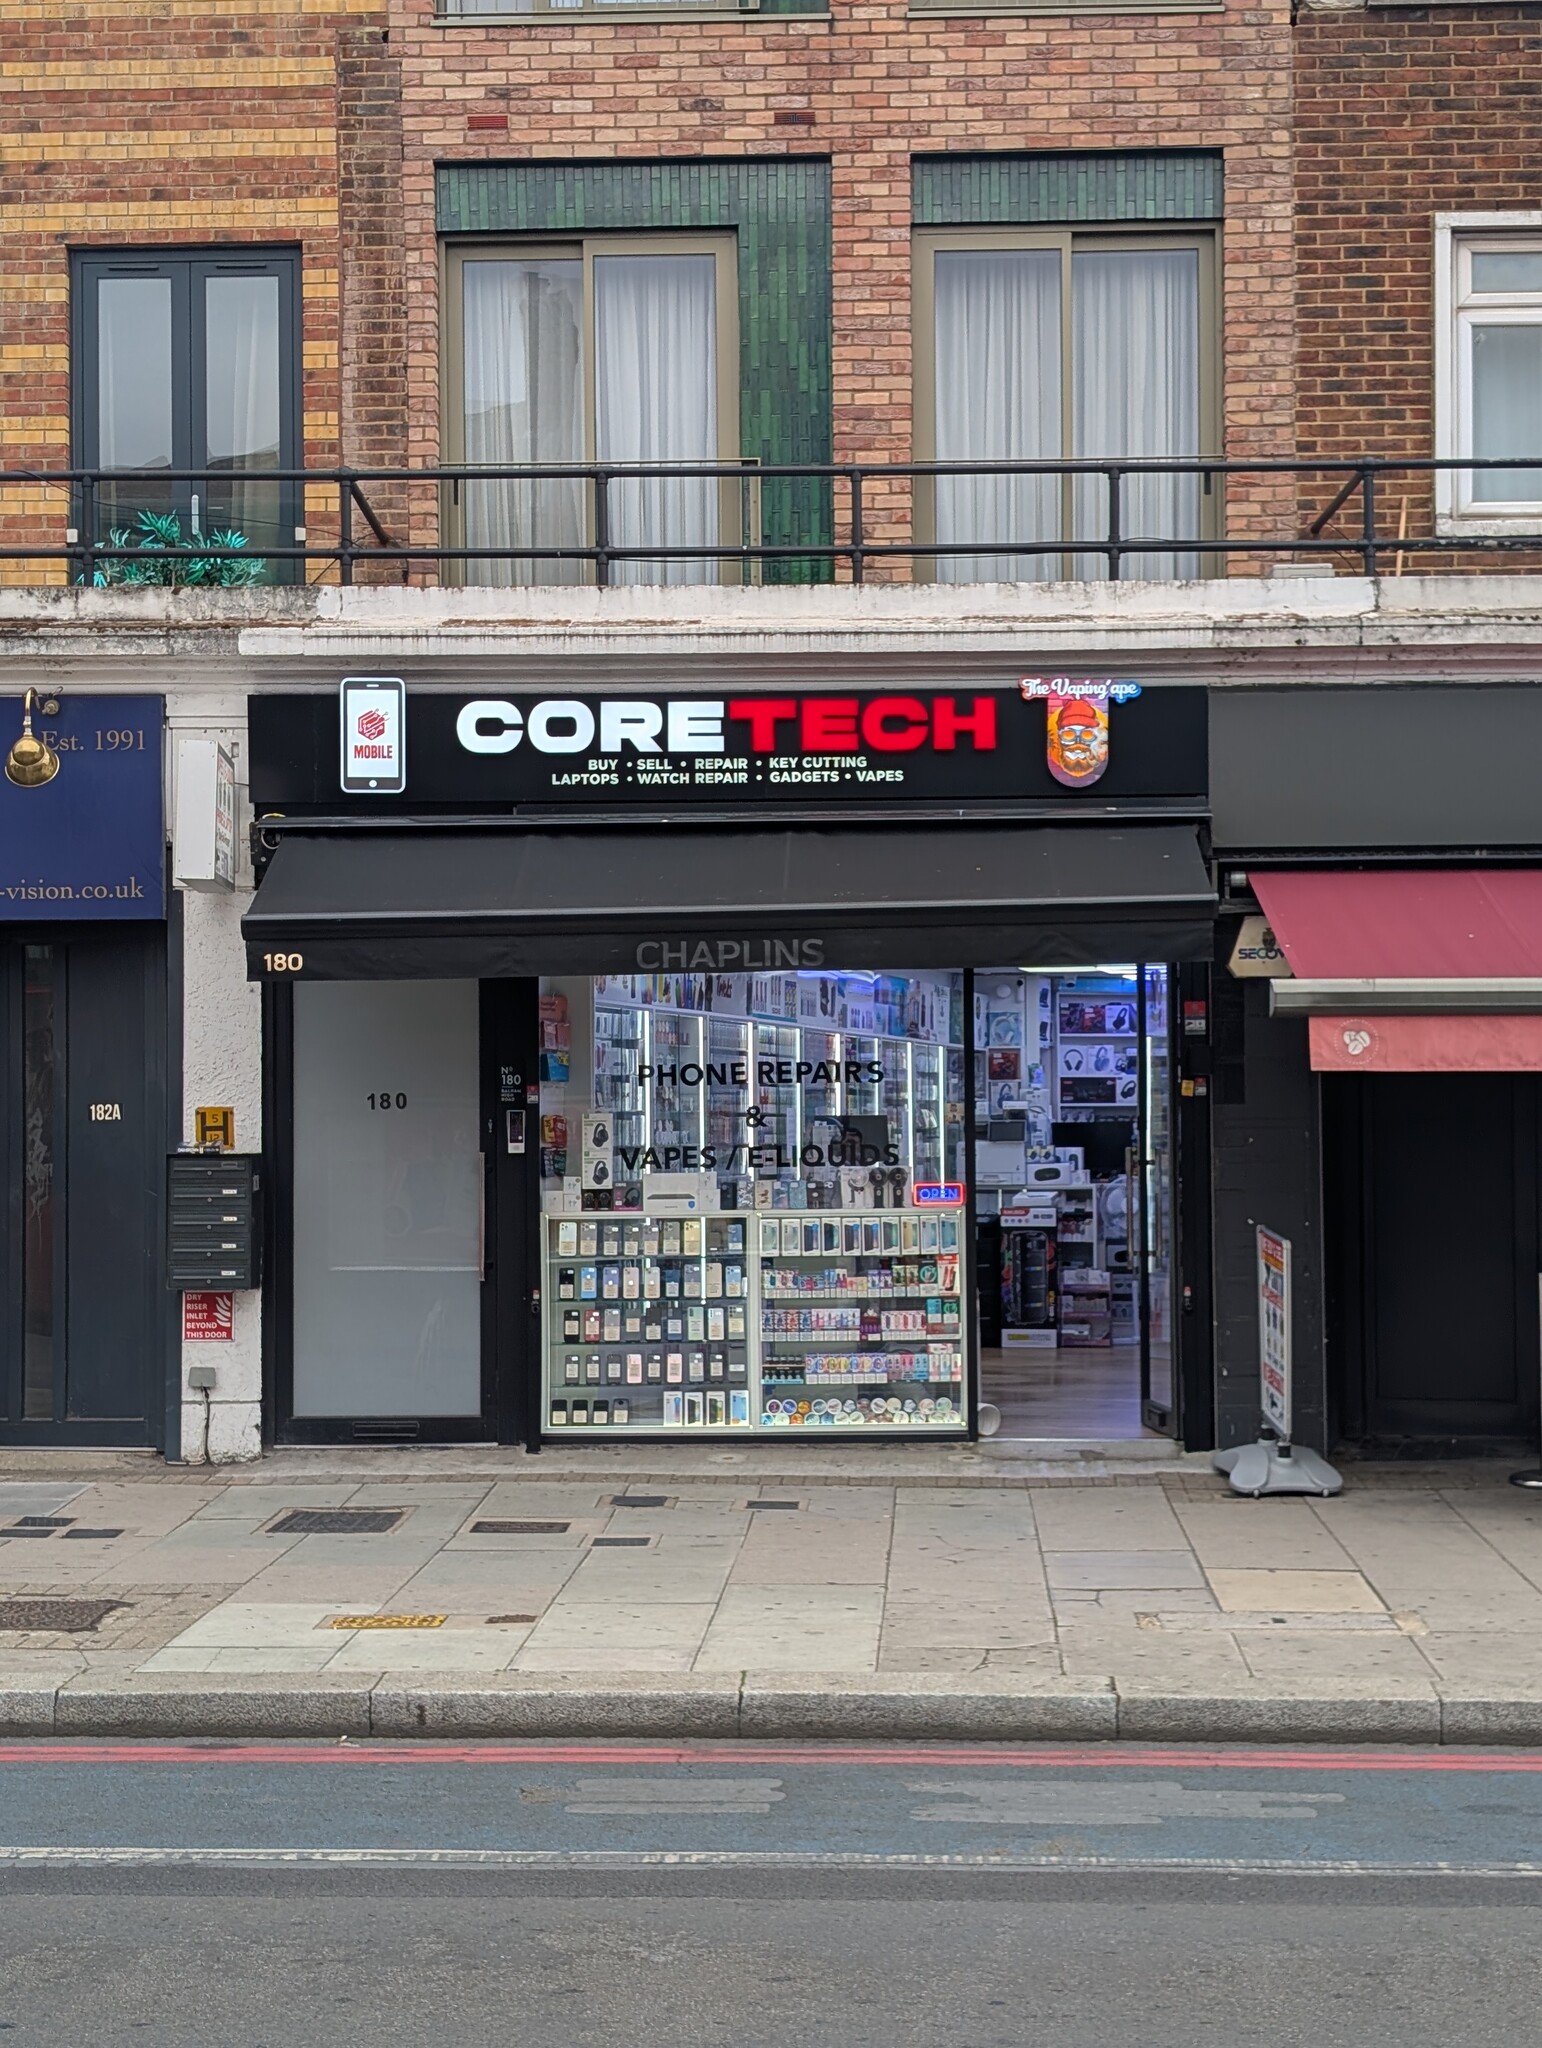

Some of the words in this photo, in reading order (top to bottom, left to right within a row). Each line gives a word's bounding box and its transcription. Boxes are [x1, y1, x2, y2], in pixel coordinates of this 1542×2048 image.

[1022, 678, 1051, 697] The
[42, 730, 84, 751] Est.
[95, 730, 146, 751] 1991
[354, 744, 393, 760] MOBILE
[588, 759, 619, 771] BUY
[636, 758, 672, 770] SELL
[695, 757, 748, 770] REPAIR
[769, 757, 799, 769] KEY
[802, 756, 868, 769] CUTTING
[551, 773, 619, 785] LAPTOPS
[637, 772, 690, 784] WATCH
[695, 772, 748, 784] REPAIR
[769, 771, 840, 783] GADGETS
[856, 770, 904, 782] VAPES
[263, 953, 304, 972] 180
[636, 938, 825, 969] CHAPLINS
[501, 1075, 521, 1085] 180
[638, 1062, 748, 1087] PHONE
[757, 1061, 885, 1085] REPAIRS
[367, 1092, 407, 1110] 180
[90, 1103, 121, 1121] 182A
[211, 1113, 219, 1124] 5
[746, 1105, 767, 1129] &
[620, 1146, 718, 1170] VAPES
[749, 1144, 900, 1168] E-LIQUIDS
[919, 1187, 959, 1200] OPEN
